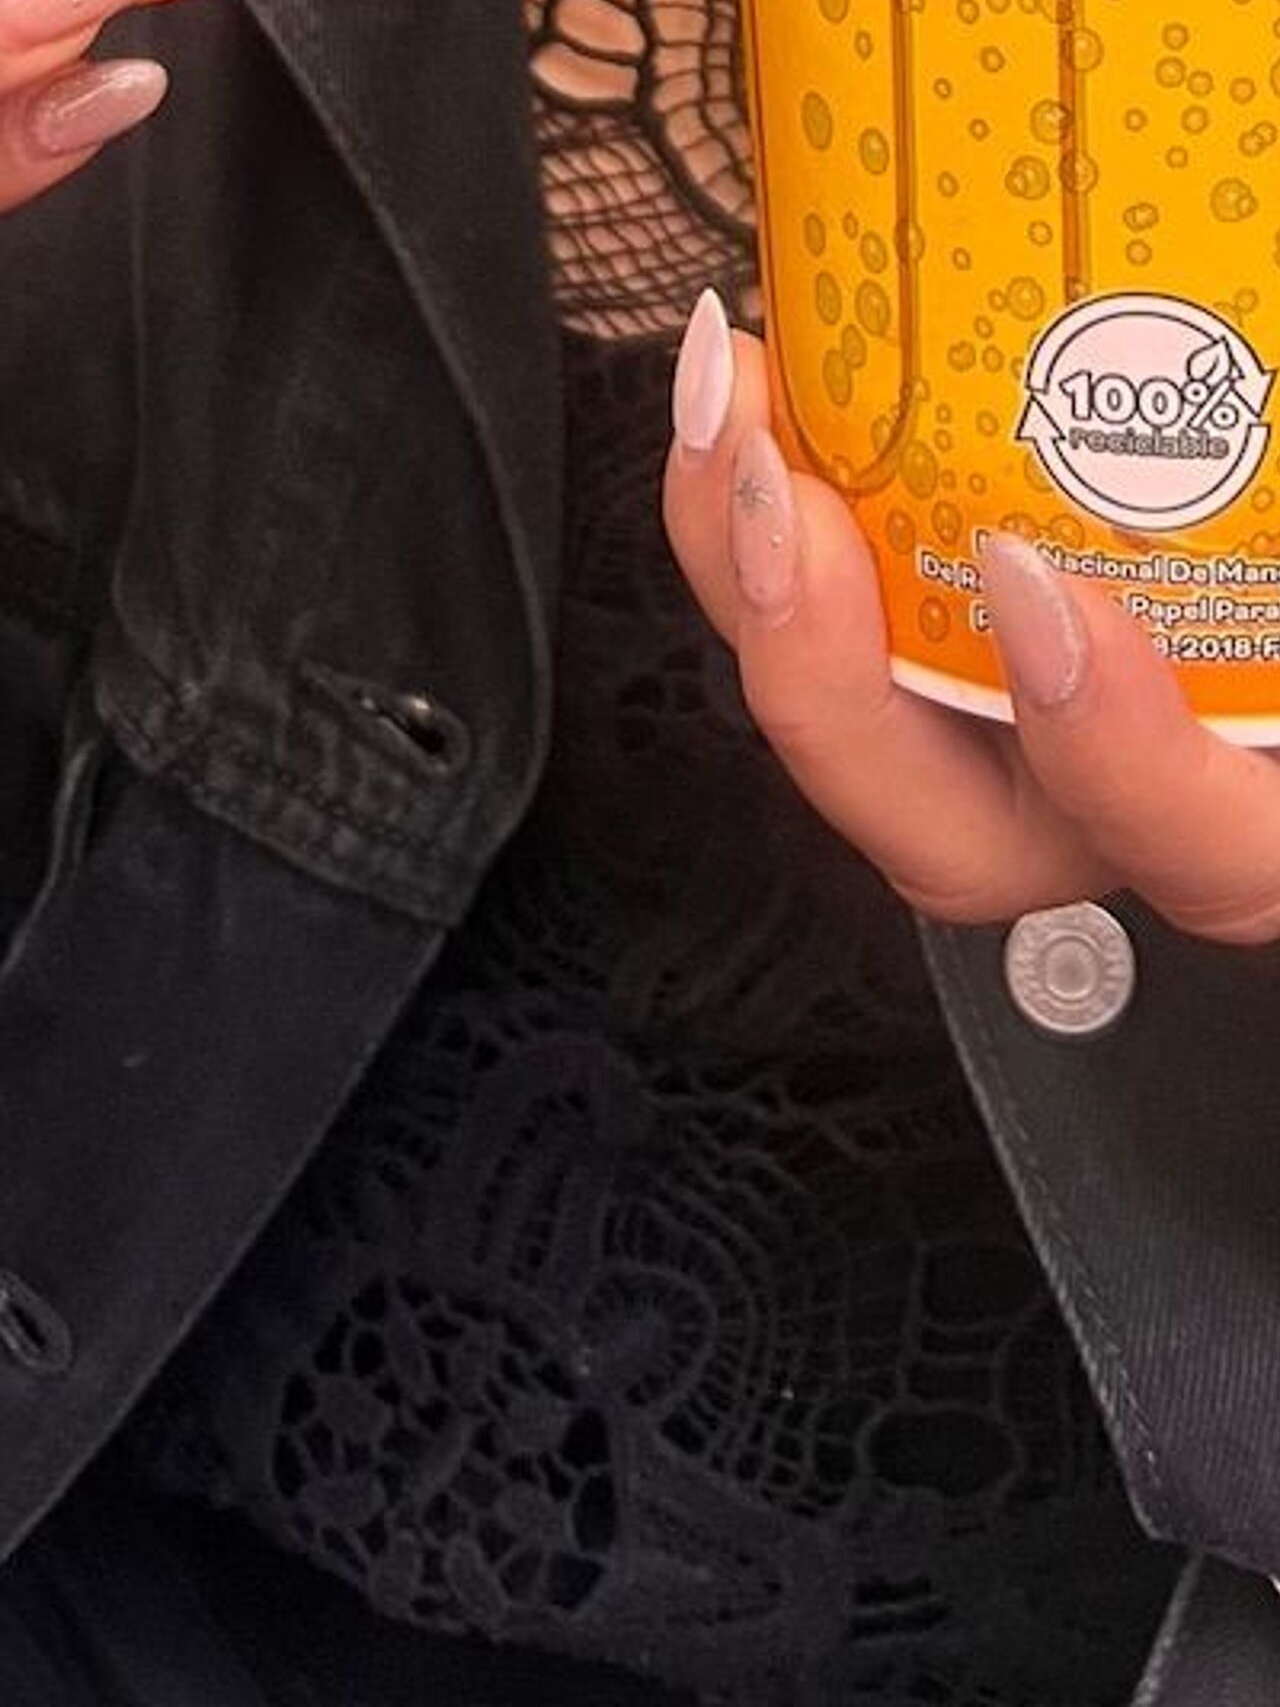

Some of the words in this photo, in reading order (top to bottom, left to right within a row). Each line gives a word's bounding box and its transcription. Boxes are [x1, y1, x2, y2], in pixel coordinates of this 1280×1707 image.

[1059, 369, 1240, 431] 100%
[1069, 426, 1230, 460] reciclable
[921, 550, 953, 586] De
[1129, 593, 1210, 628] Papel
[1215, 597, 1280, 623] Para
[1169, 558, 1209, 583] De
